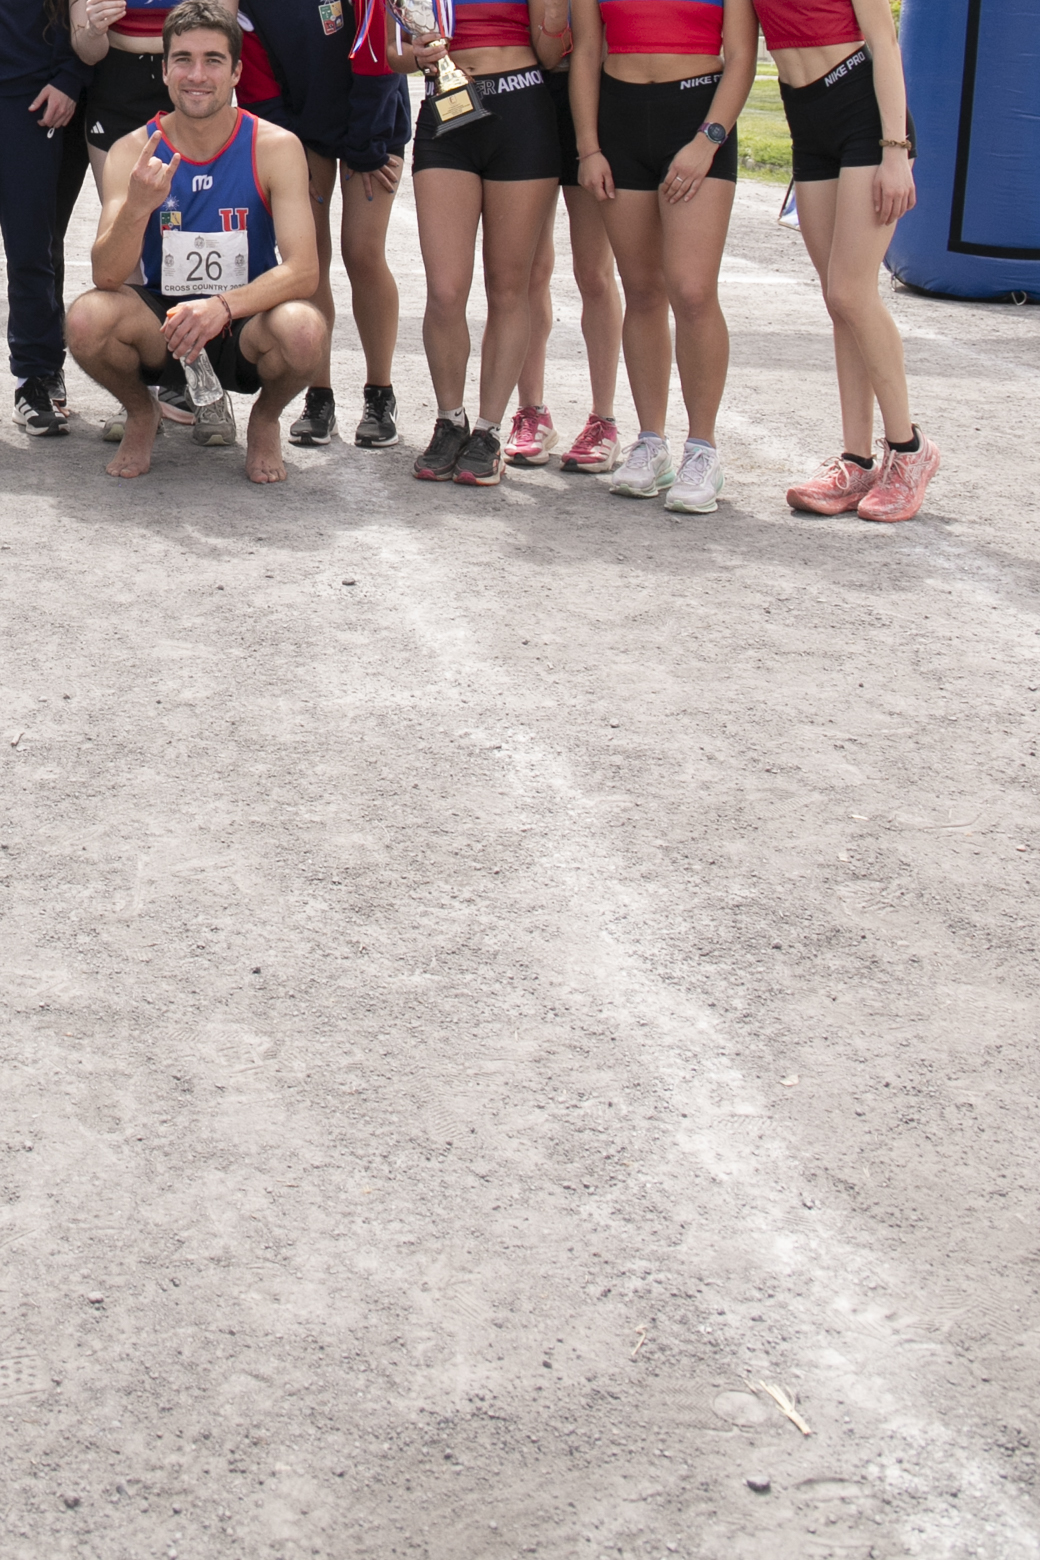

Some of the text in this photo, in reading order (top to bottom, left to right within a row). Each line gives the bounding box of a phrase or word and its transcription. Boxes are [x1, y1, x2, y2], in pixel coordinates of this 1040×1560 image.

[498, 70, 544, 94] ARMO
[824, 51, 866, 87] NIKE PRO
[680, 76, 712, 90] NIKE
[186, 251, 223, 282] 26
